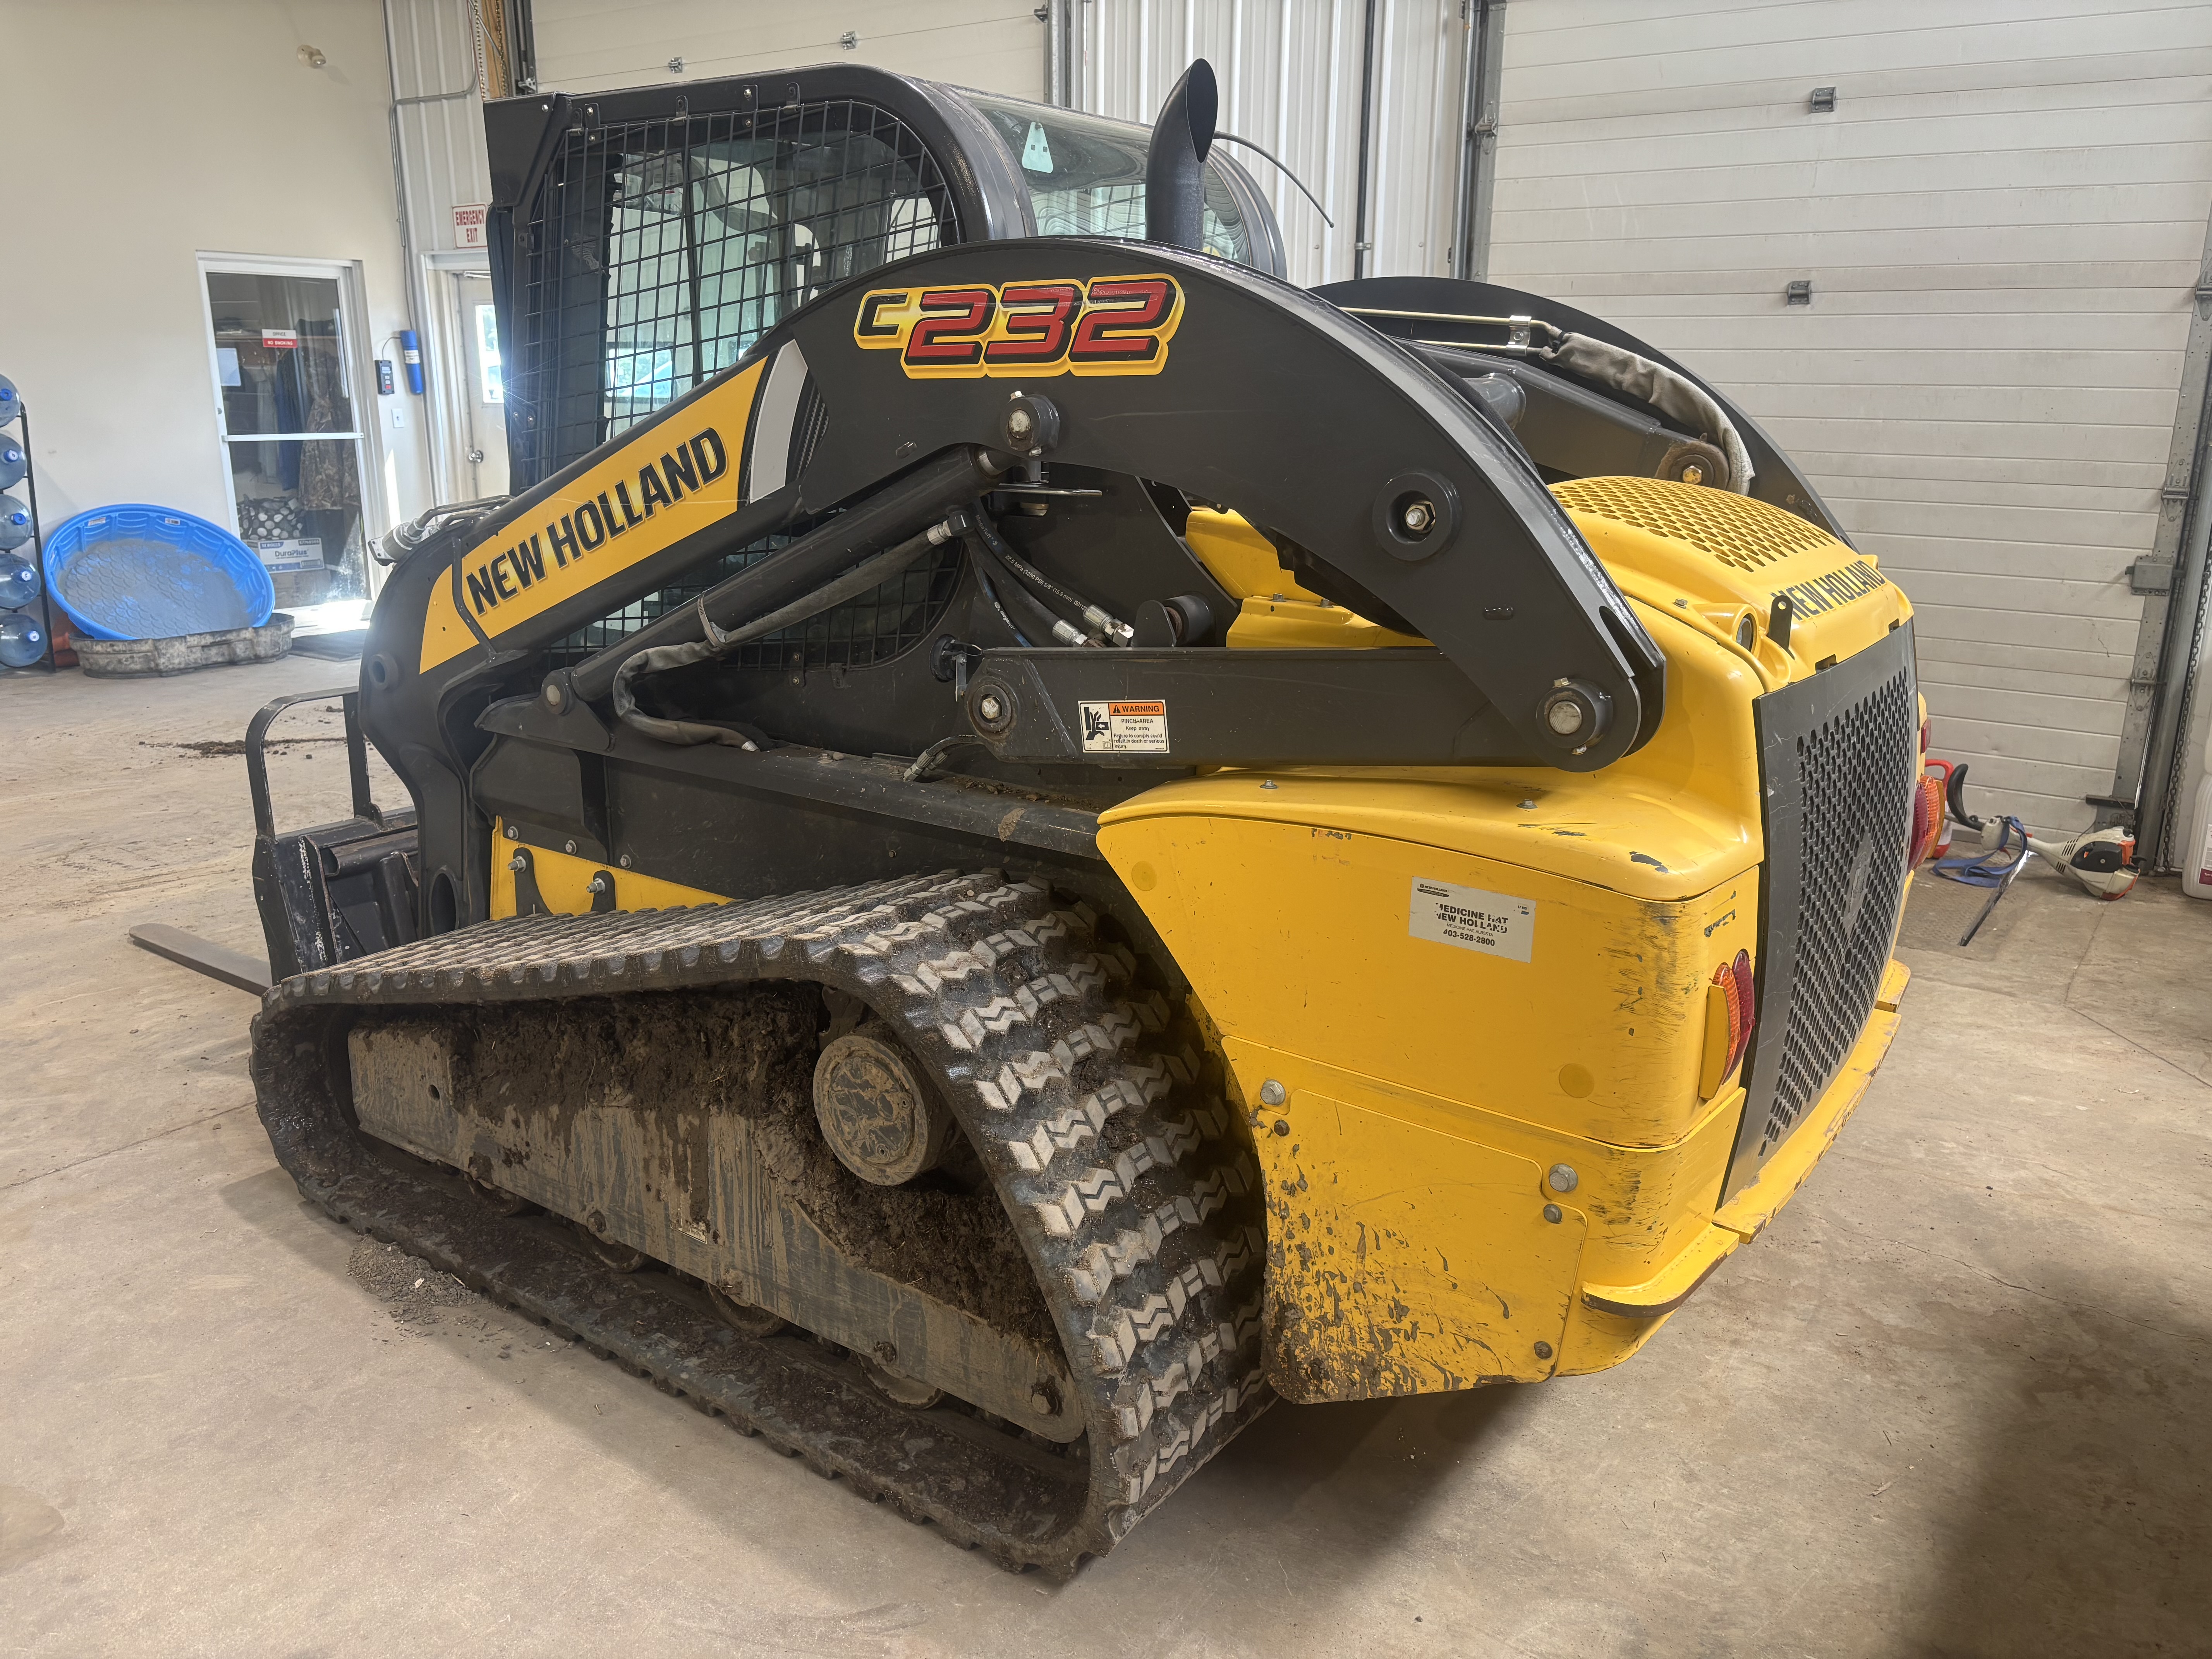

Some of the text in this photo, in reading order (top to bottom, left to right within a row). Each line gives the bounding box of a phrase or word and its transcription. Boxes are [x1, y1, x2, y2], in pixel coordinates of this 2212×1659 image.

[455, 210, 484, 226] EMERGENCY
[466, 227, 477, 242] EXIT
[857, 277, 1177, 367] C232
[466, 427, 727, 615] NEW HOLLAND
[1014, 562, 1024, 572] MPa
[1812, 560, 1886, 606] HOLLAND
